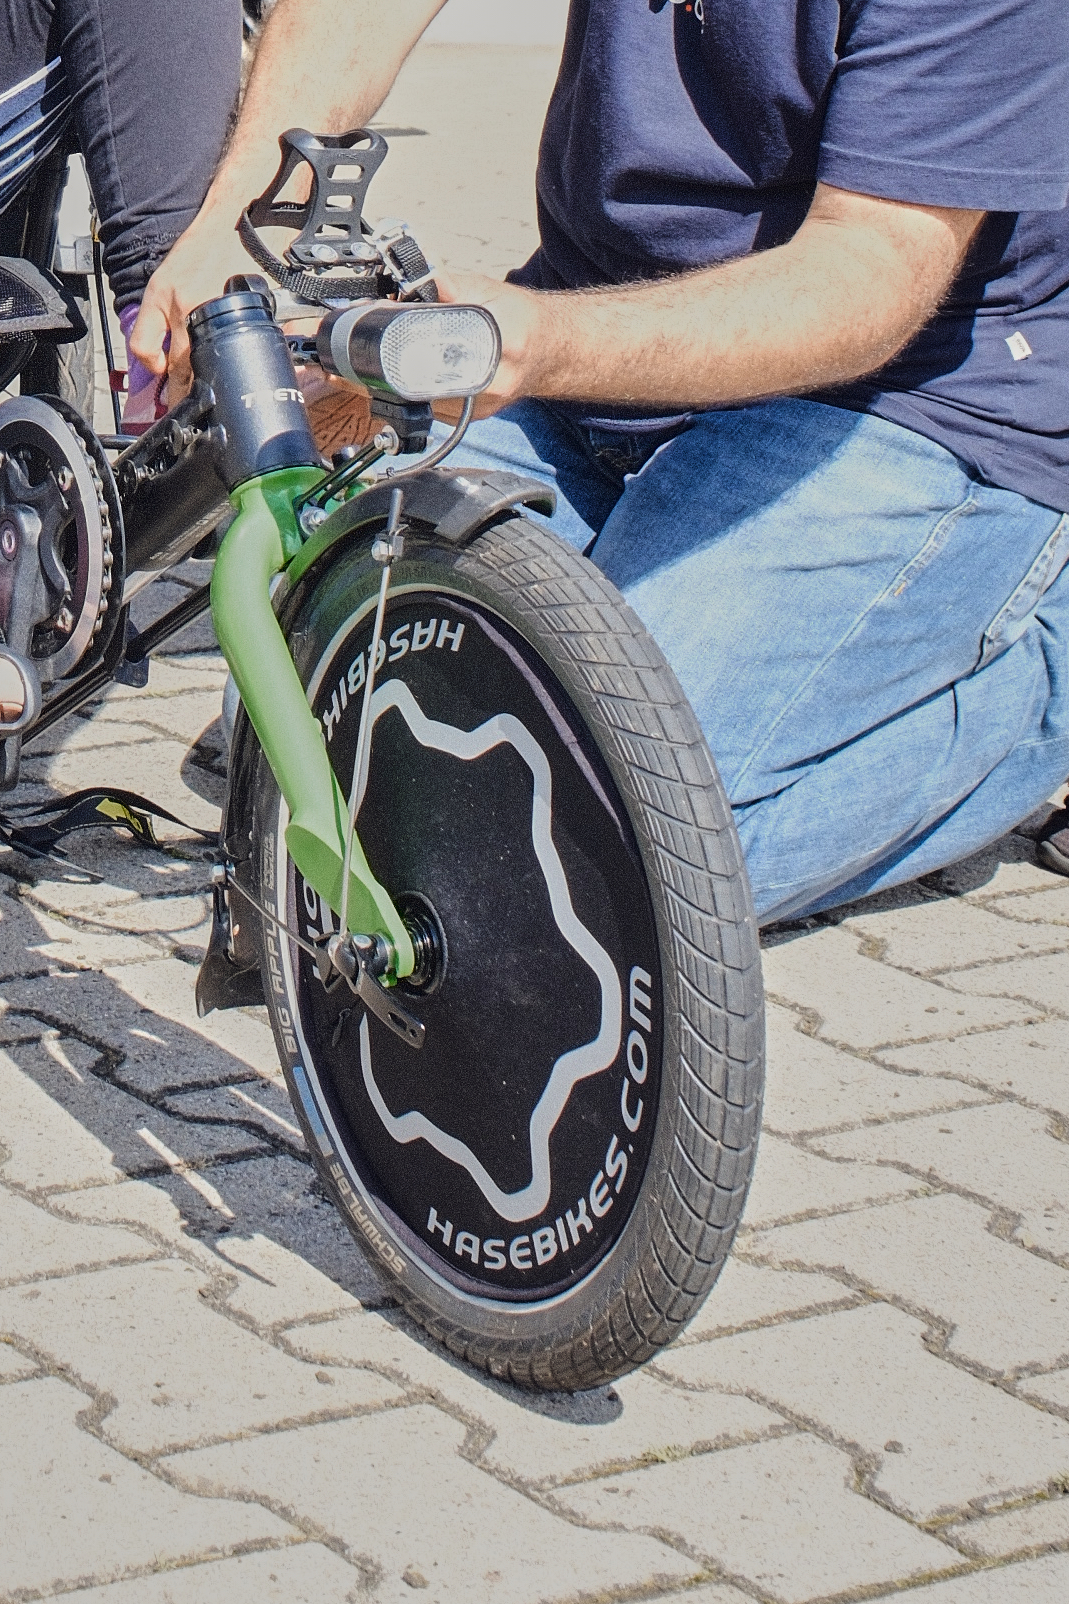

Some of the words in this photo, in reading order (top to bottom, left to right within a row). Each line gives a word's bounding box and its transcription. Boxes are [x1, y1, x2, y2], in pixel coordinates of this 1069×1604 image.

[240, 387, 305, 409] TETS
[263, 899, 286, 995] APPLE
[277, 1006, 298, 1054] BIG
[330, 1162, 407, 1273] SCHWALBE
